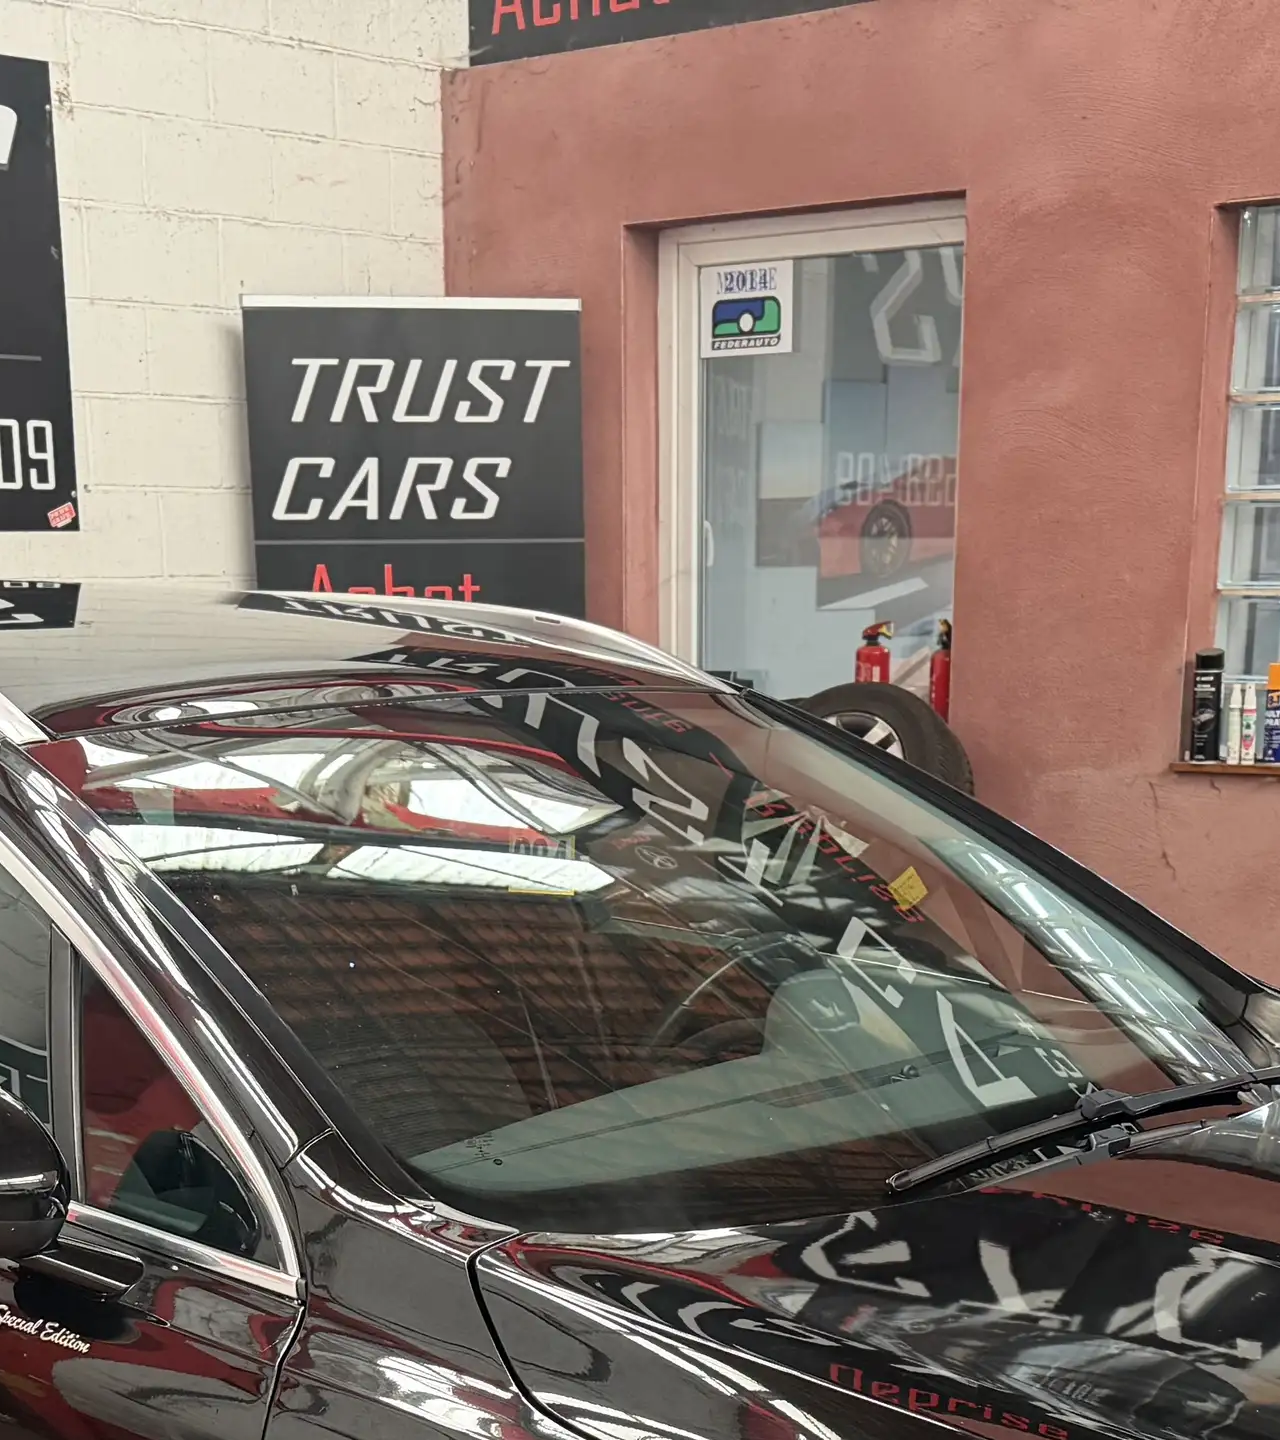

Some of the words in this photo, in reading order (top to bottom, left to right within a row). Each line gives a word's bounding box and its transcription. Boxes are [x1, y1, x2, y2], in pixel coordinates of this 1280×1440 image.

[713, 336, 779, 350] FEDERAUTO
[290, 358, 571, 424] TRUST
[272, 457, 512, 521] CARS
[311, 563, 482, 603] Aht
[39, 1321, 91, 1354] Edition
